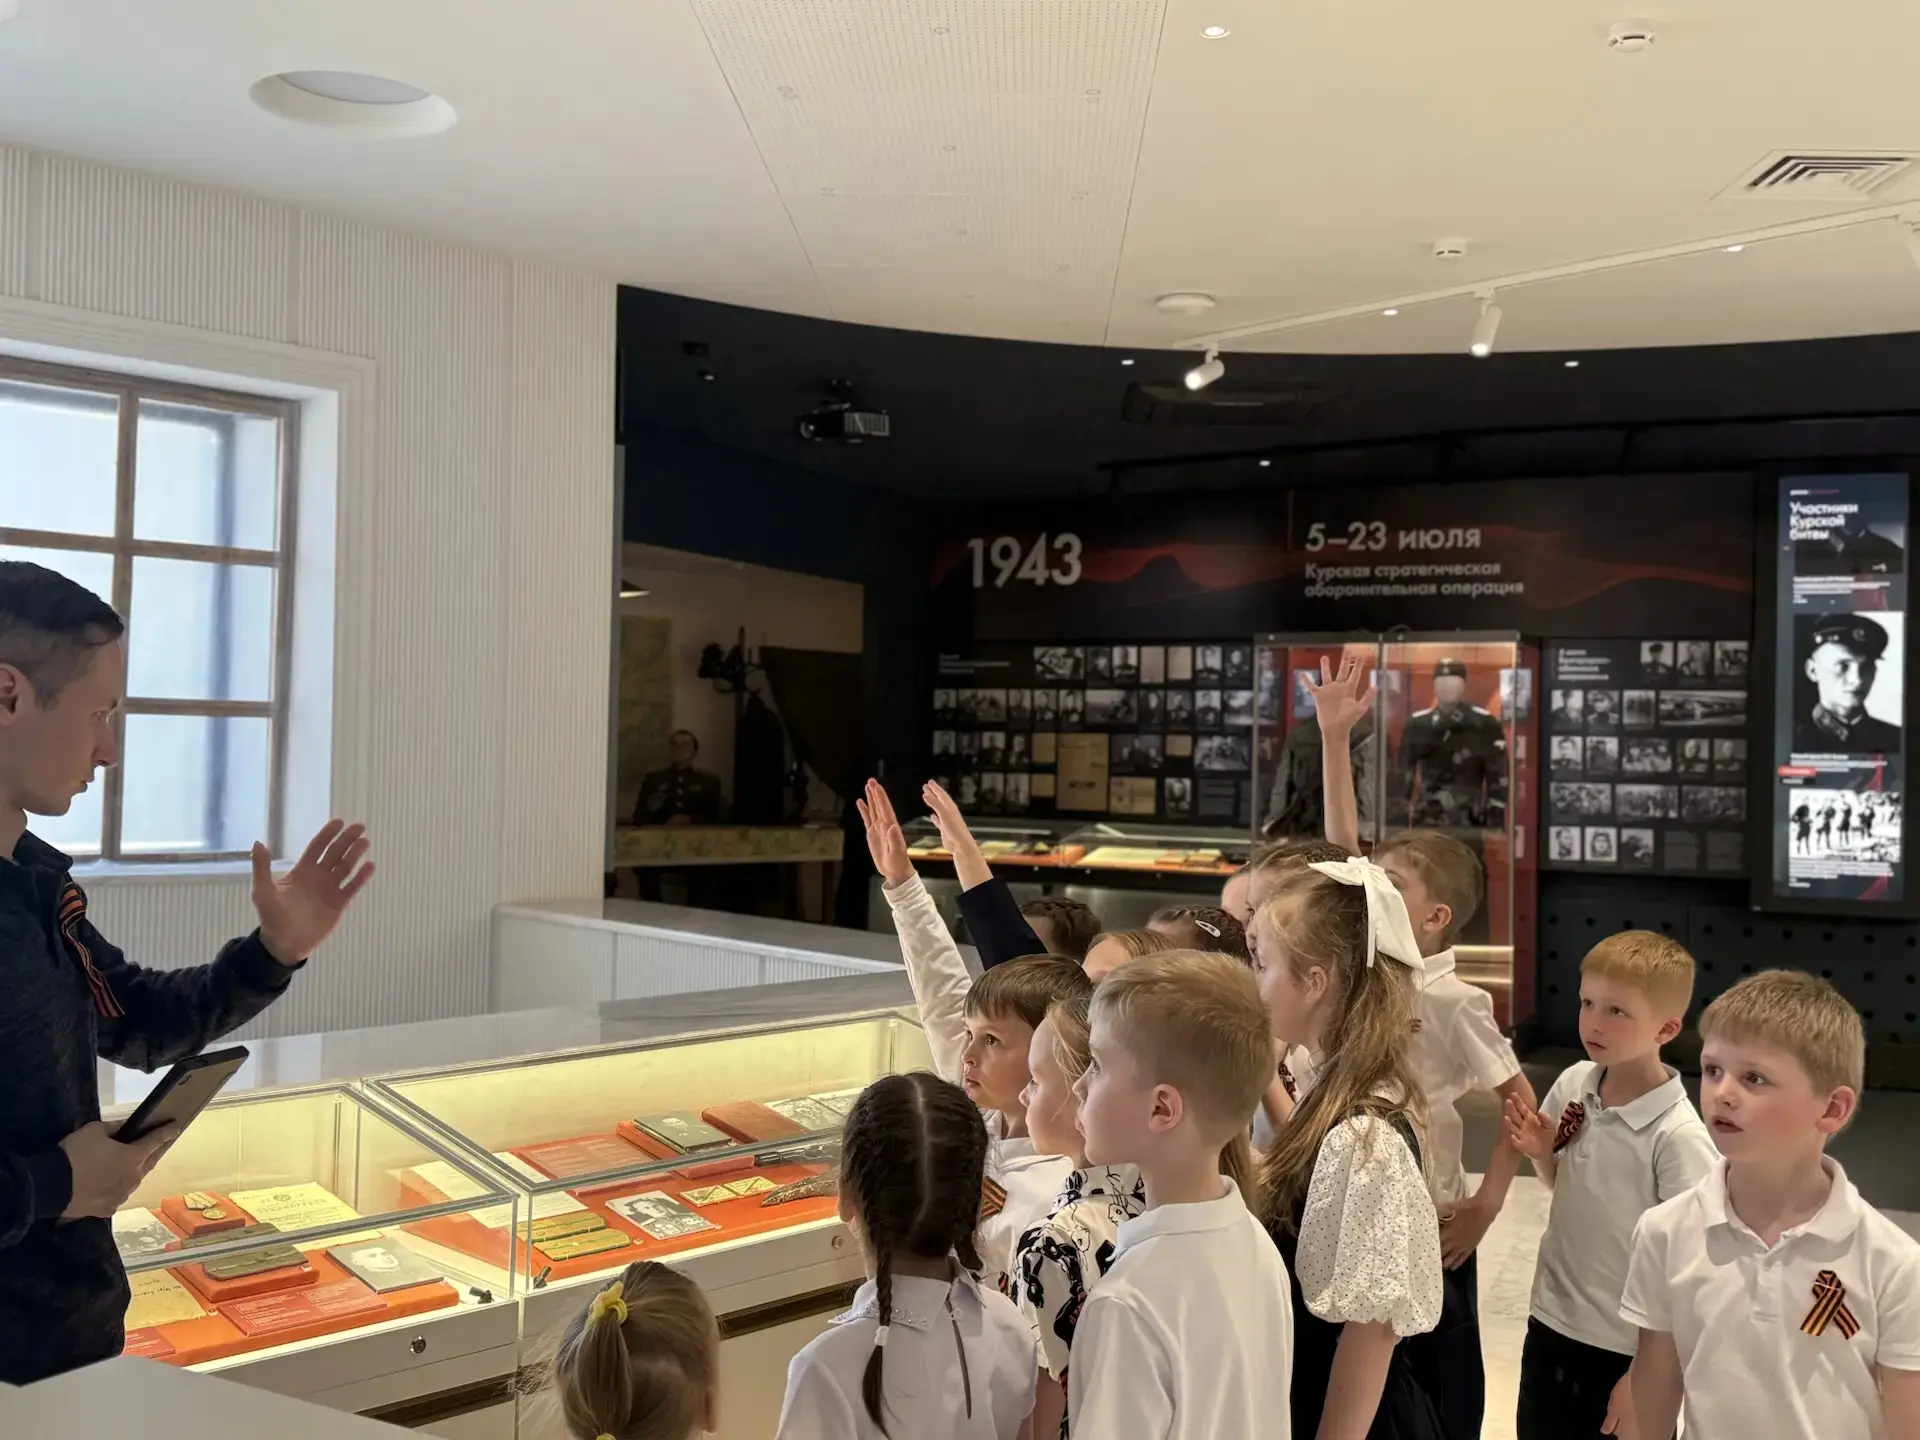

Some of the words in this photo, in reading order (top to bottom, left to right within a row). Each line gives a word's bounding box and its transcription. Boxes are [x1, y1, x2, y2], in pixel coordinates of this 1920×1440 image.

[1789, 501, 1859, 515] Участники
[1789, 514, 1846, 530] Курской
[1398, 528, 1482, 550] июля
[1789, 527, 1830, 541] битвы
[966, 531, 1083, 588] 1943
[1304, 562, 1371, 583] Курская
[1373, 561, 1502, 581] стратегическая
[1303, 581, 1438, 600] оборонительная
[1440, 580, 1525, 598] операция
